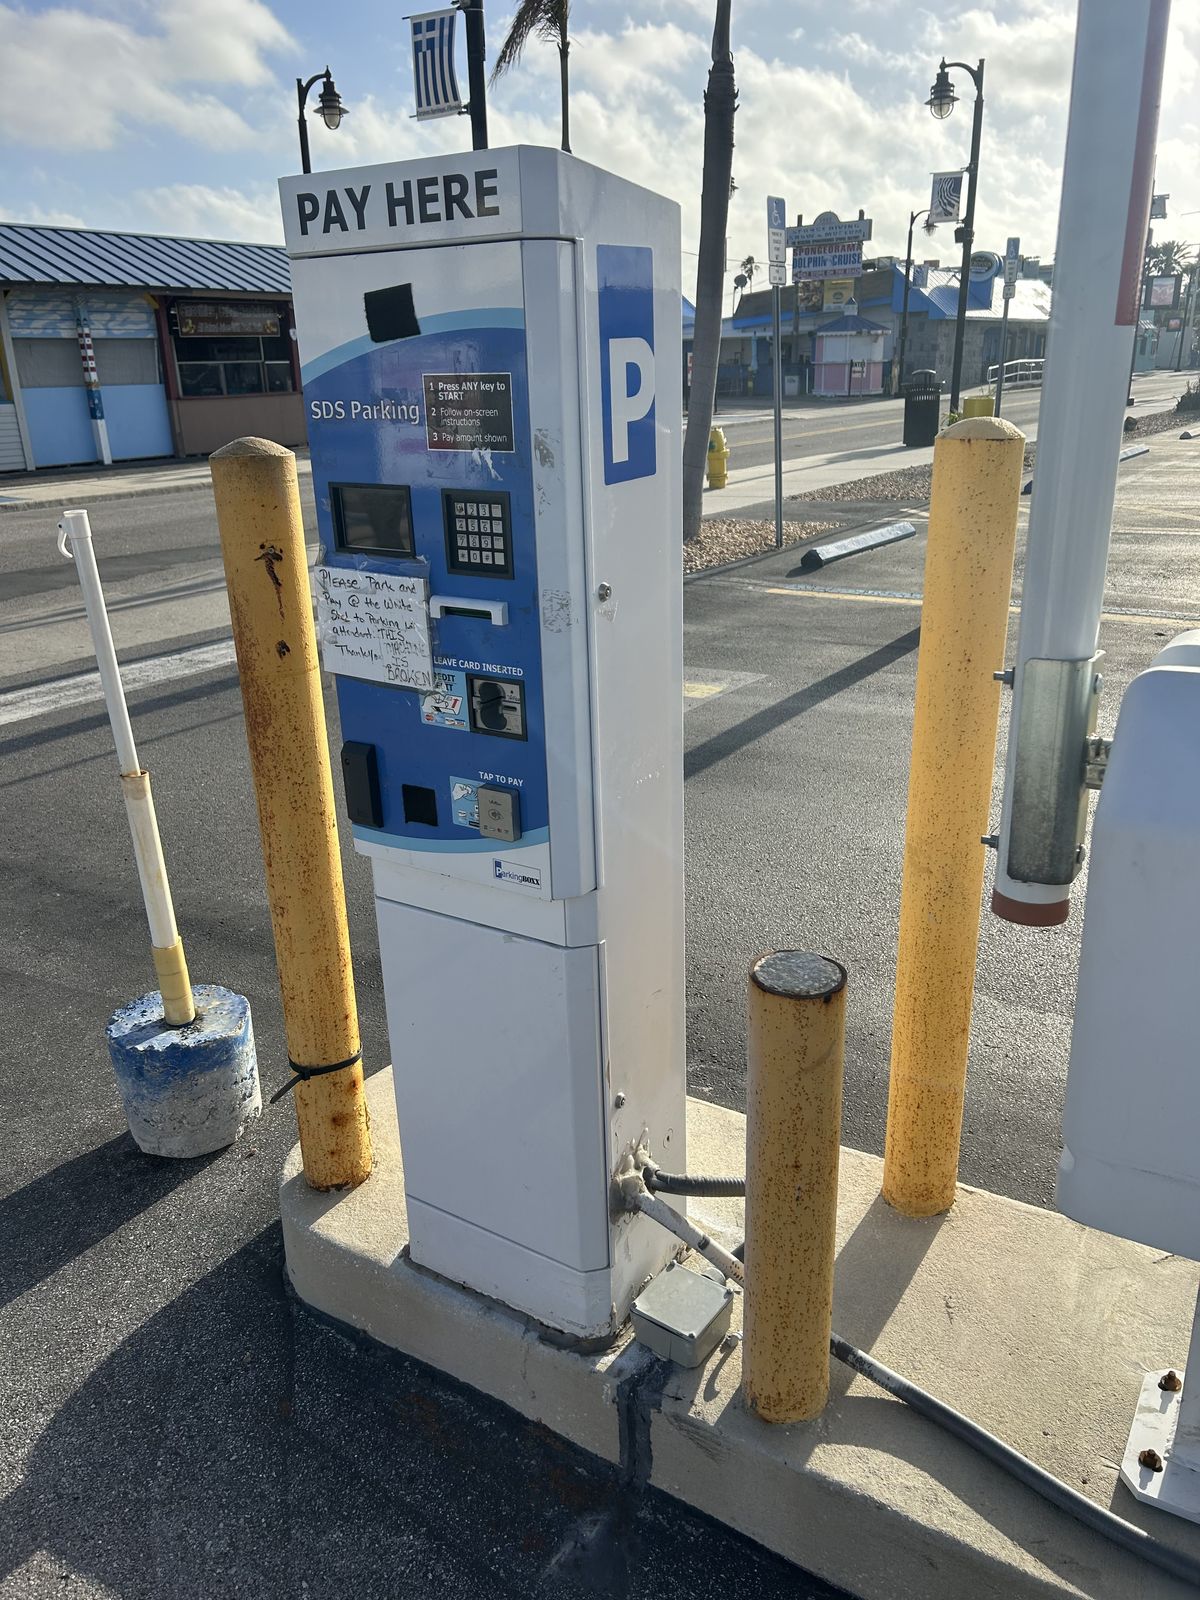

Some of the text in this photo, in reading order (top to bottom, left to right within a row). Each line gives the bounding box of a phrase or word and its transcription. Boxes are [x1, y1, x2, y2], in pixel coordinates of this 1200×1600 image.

[296, 168, 500, 236] PAY HERE
[793, 253, 861, 269] DOLPHIN CRUISE
[429, 381, 506, 392] 1 Press ANY key to
[438, 392, 464, 400] START
[609, 337, 655, 464] P
[311, 400, 420, 424] SDS Parking
[431, 408, 499, 417] 2 Follow on-screen
[441, 417, 481, 426] instructions
[432, 432, 508, 443] 3 Pay amount shown
[365, 575, 395, 592] Park
[399, 583, 417, 594] and
[348, 594, 360, 608] @
[365, 597, 381, 609] the
[384, 599, 413, 612] White
[353, 613, 364, 622] to
[365, 612, 400, 629] Parking
[377, 628, 405, 641] THIS
[391, 656, 409, 668] IS
[433, 655, 524, 676] LEAVE CARD INSERTED
[385, 663, 431, 687] BROKEN
[478, 771, 524, 787] TAP TO PAY
